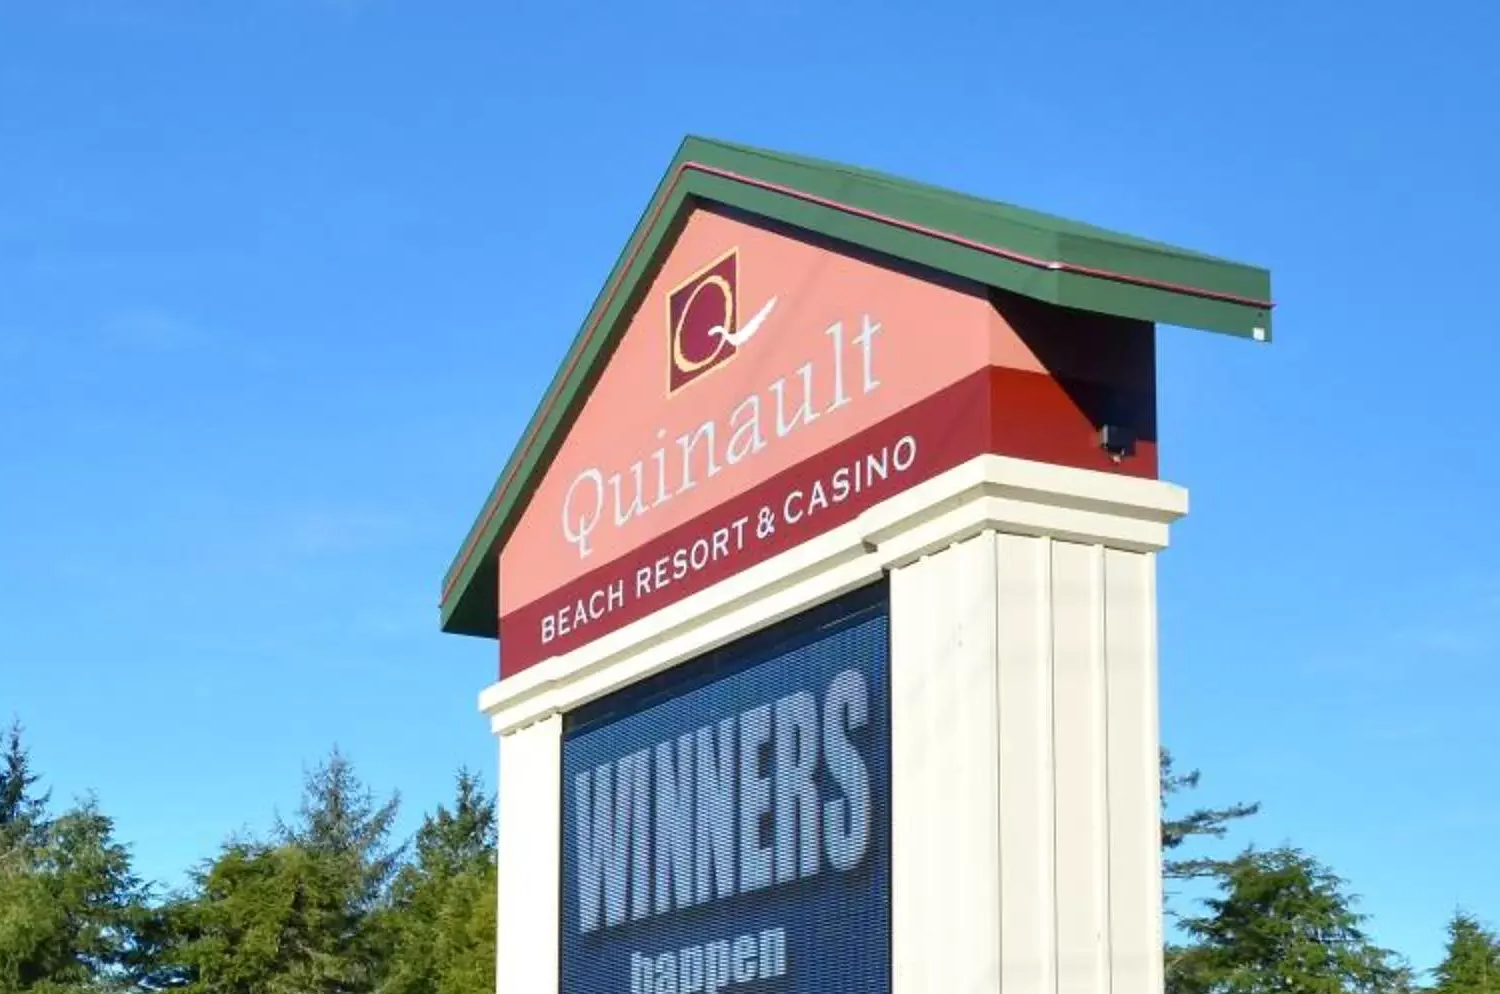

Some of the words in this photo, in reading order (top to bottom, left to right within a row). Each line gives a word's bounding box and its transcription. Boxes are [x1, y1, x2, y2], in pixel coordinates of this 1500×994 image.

[540, 579, 624, 644] BEACH
[636, 516, 748, 598] RESORT
[756, 506, 776, 540] &
[783, 435, 918, 524] CASINO
[562, 314, 881, 558] Quinault
[575, 667, 871, 934] WINNERS
